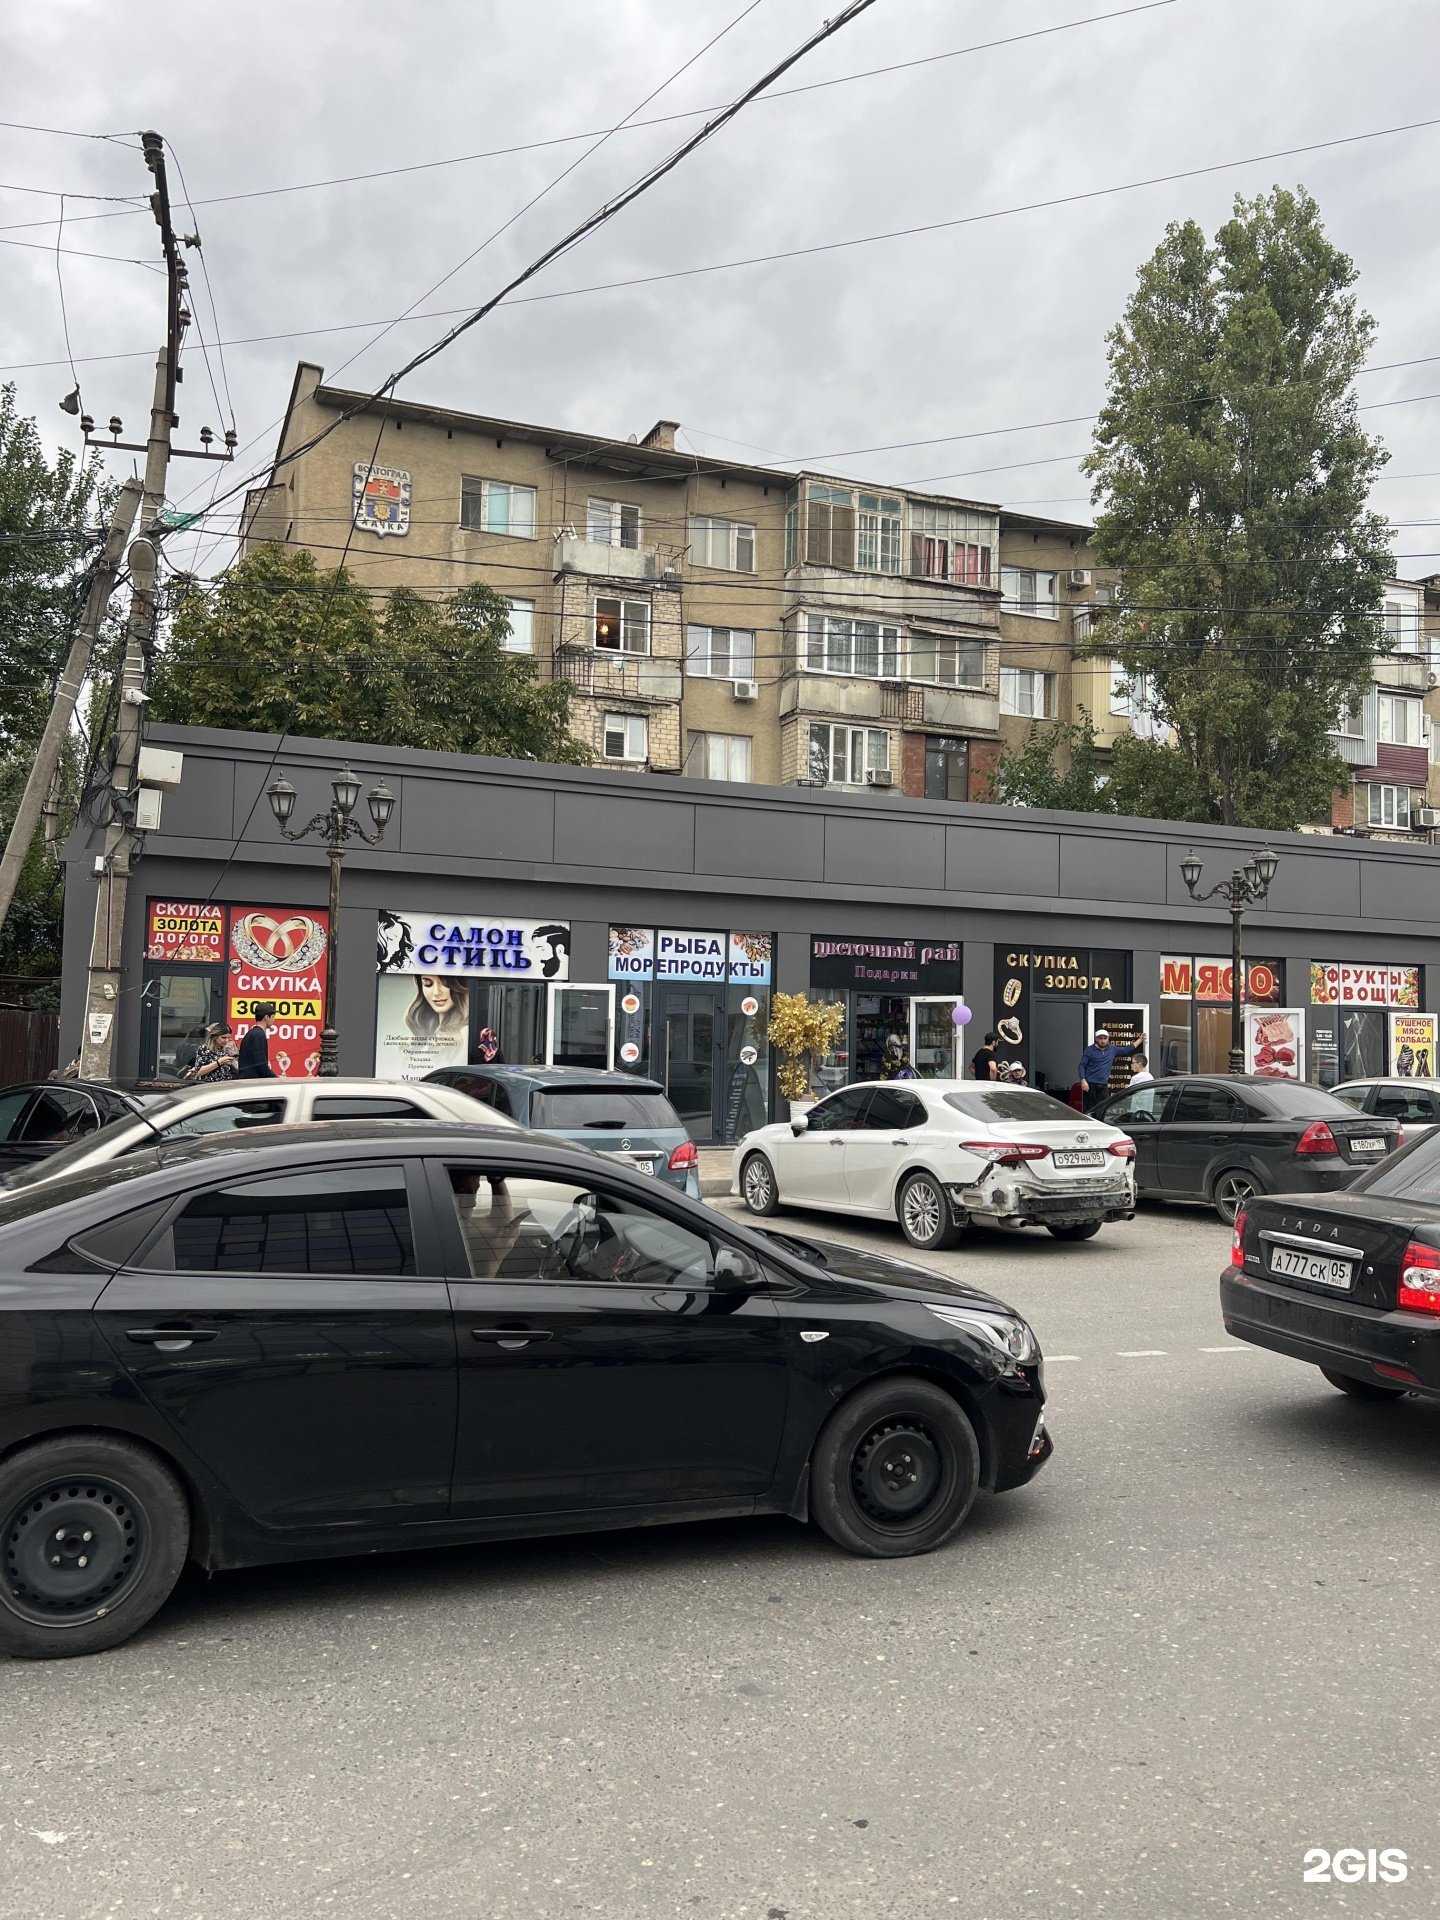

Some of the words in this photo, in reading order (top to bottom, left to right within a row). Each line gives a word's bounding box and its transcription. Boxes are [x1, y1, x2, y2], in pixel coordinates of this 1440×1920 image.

[358, 465, 408, 480] ВОЛГОГРАД
[156, 903, 221, 918] СКУПКА
[157, 919, 219, 932] ЗОЛОТА
[155, 934, 219, 945] ДОРОГО
[429, 924, 524, 946] САЛОН
[661, 937, 721, 955] РЫБА
[418, 945, 532, 969] СТИЛЬ
[1007, 953, 1079, 969] СКУПКА
[615, 957, 764, 978] МОРЕПРОДУКТЫ
[854, 966, 918, 982] Подарки
[237, 975, 322, 992] СКУПКА
[1045, 975, 1112, 990] ЗОЛОТА
[1326, 967, 1402, 986] ФРУКТЫ
[1329, 985, 1399, 1004] ОВОЩИ
[236, 999, 317, 1016] ЗООТА
[235, 1024, 317, 1041] ДРОГО
[1281, 1217, 1338, 1237] LADA
[1331, 1262, 1346, 1279] 05
